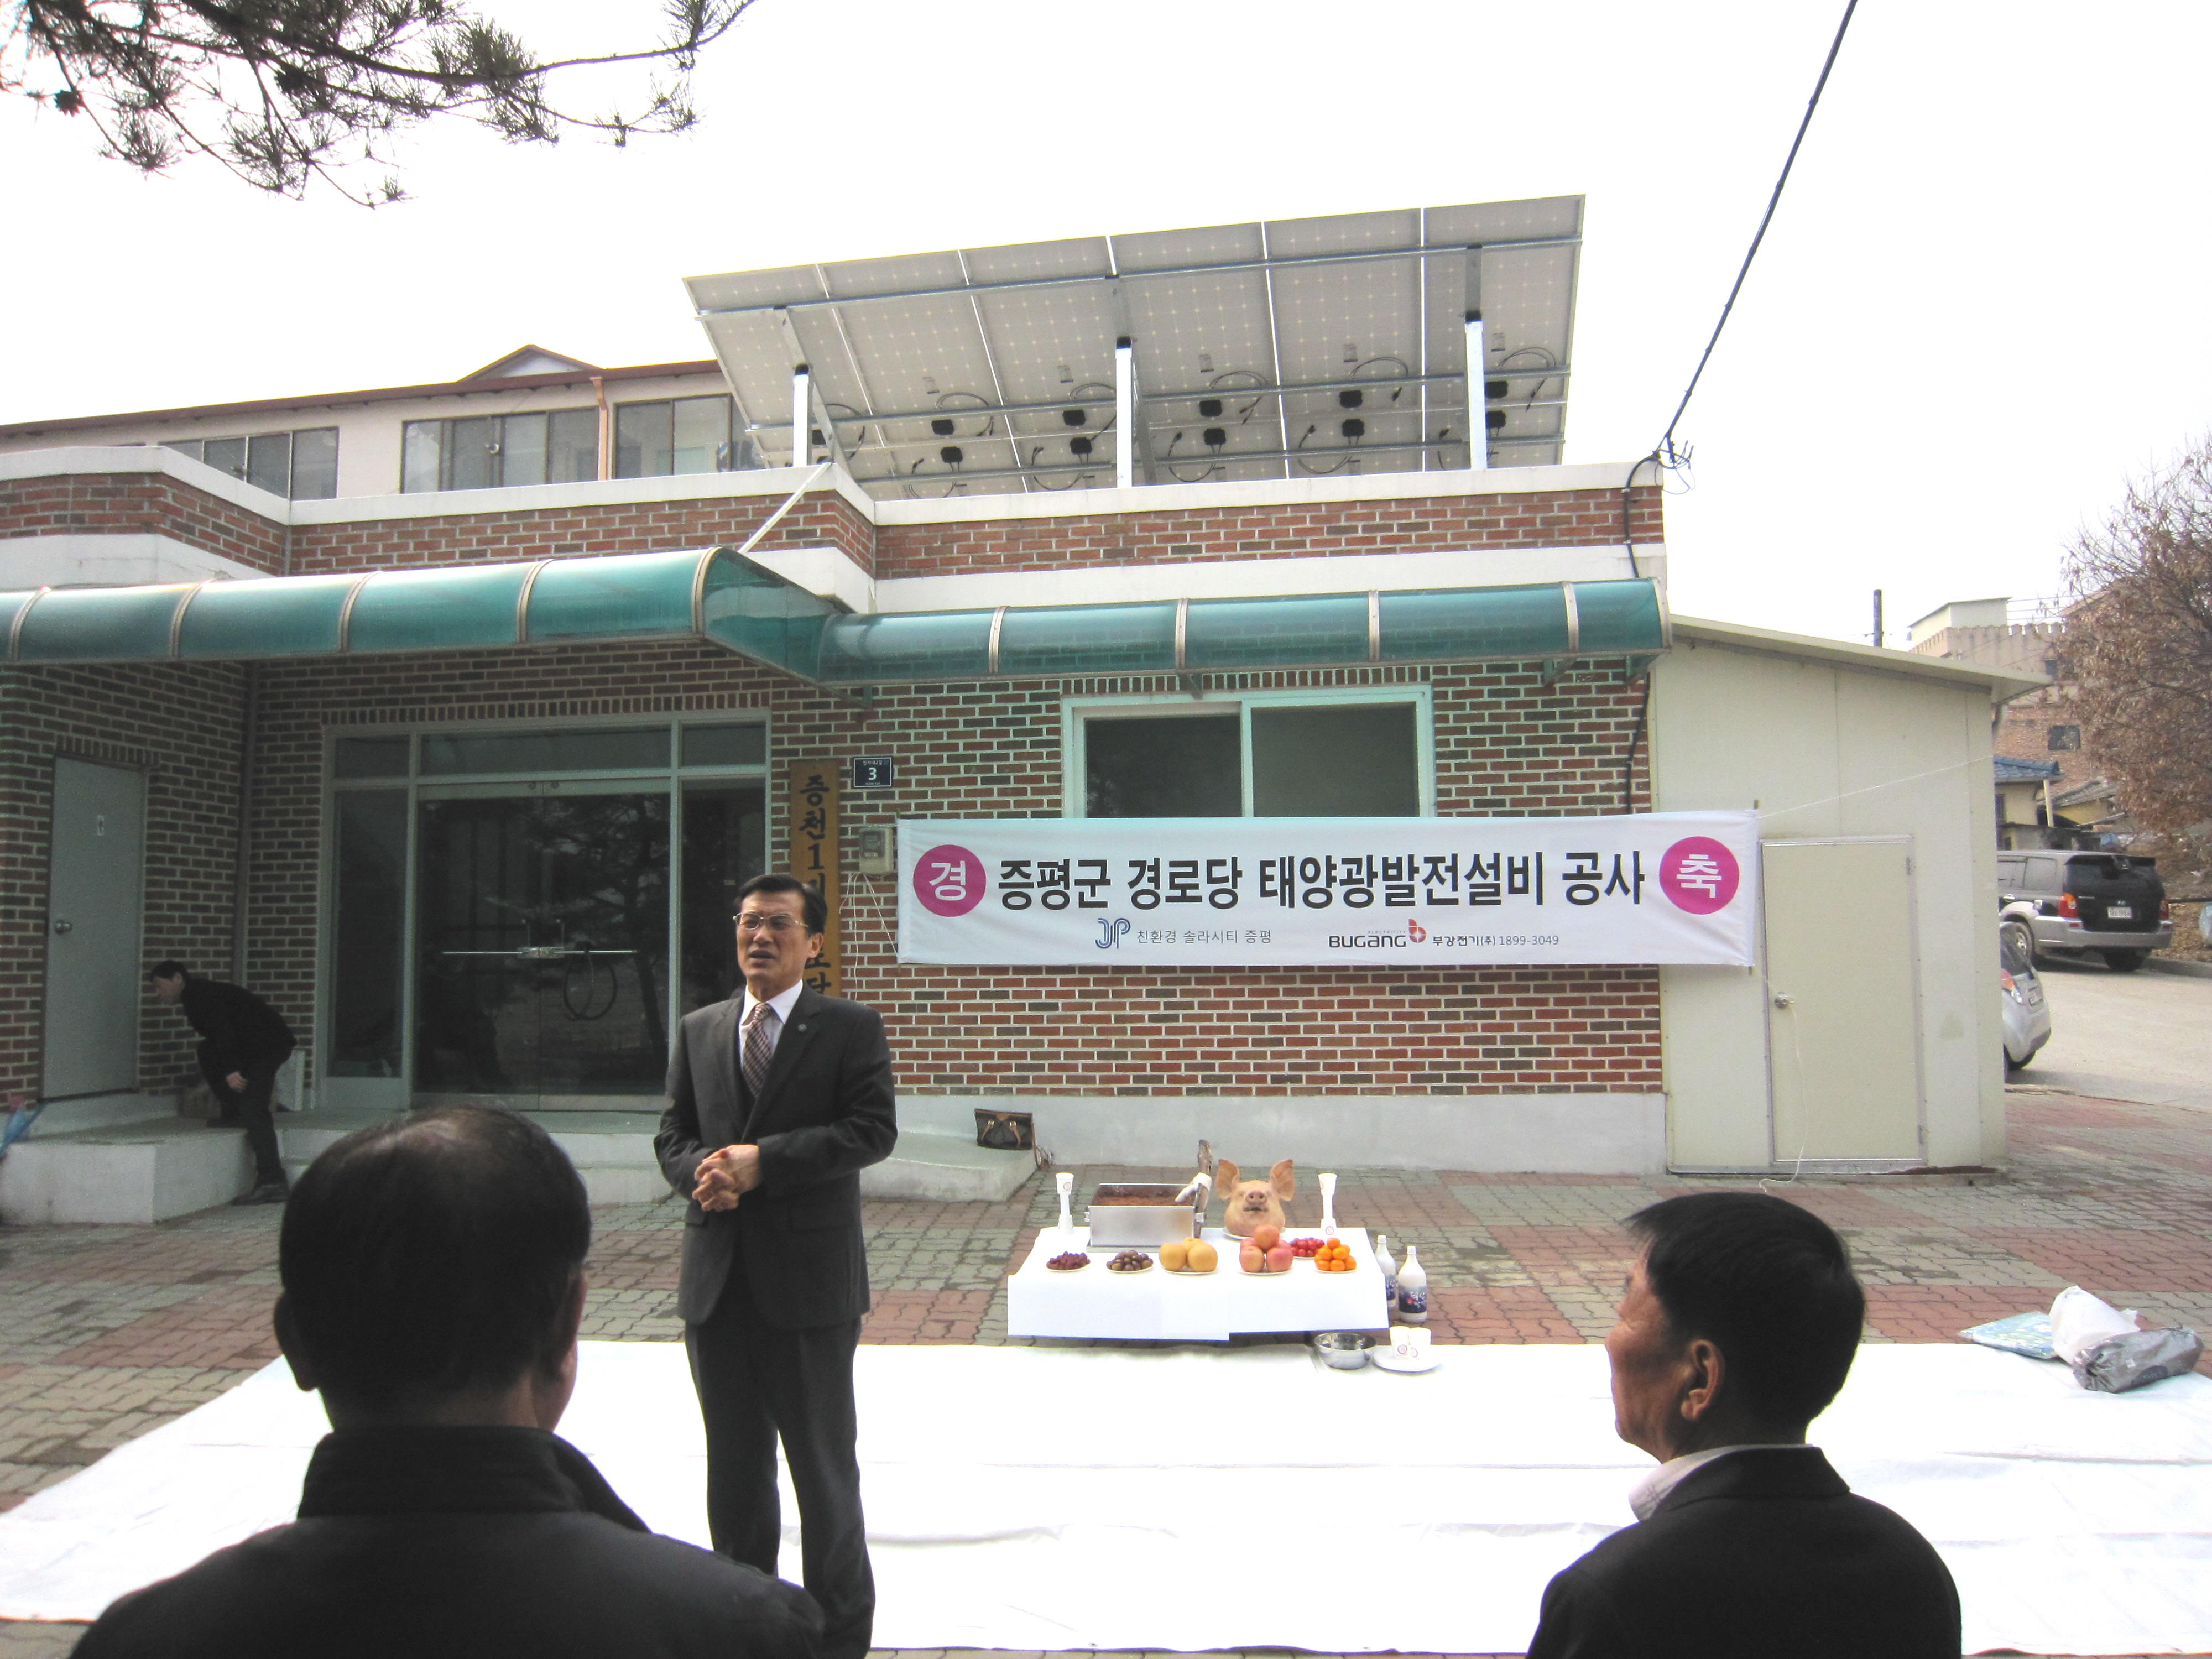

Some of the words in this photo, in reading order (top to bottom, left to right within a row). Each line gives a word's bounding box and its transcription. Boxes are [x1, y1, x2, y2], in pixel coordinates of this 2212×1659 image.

[868, 767, 877, 780] 3
[929, 861, 967, 902] 경
[998, 858, 1112, 911] 증평군
[1127, 856, 1243, 911] 경로당
[1259, 852, 1543, 910] 태양광발전설비
[1562, 851, 1646, 906] 공사
[1675, 853, 1722, 899] 축
[1136, 930, 1177, 944] 친환경
[1183, 930, 1238, 944] 솔라시티
[1244, 930, 1272, 944] 증평
[1432, 935, 1496, 947] 부강전기(주)
[1499, 935, 1559, 946] 1899-3049
